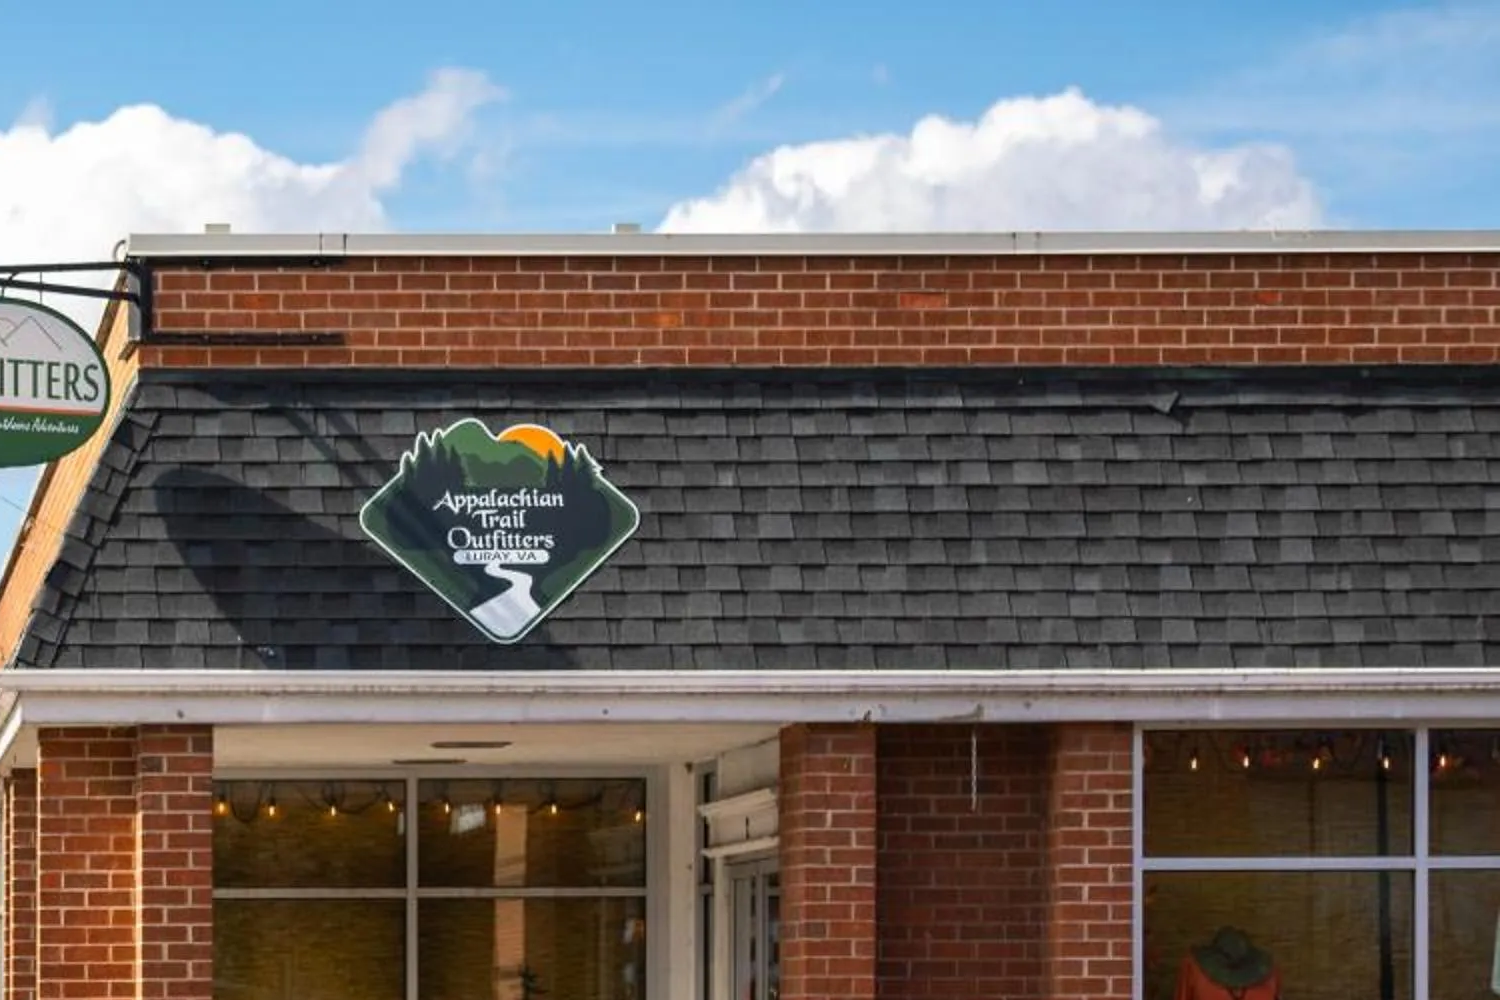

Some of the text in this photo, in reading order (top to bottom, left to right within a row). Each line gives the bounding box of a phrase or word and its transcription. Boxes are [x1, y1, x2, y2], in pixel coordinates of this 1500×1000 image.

[432, 488, 564, 514] Appalachian
[471, 509, 527, 529] Trail
[447, 527, 555, 551] Outfitters
[517, 552, 537, 561] VA
